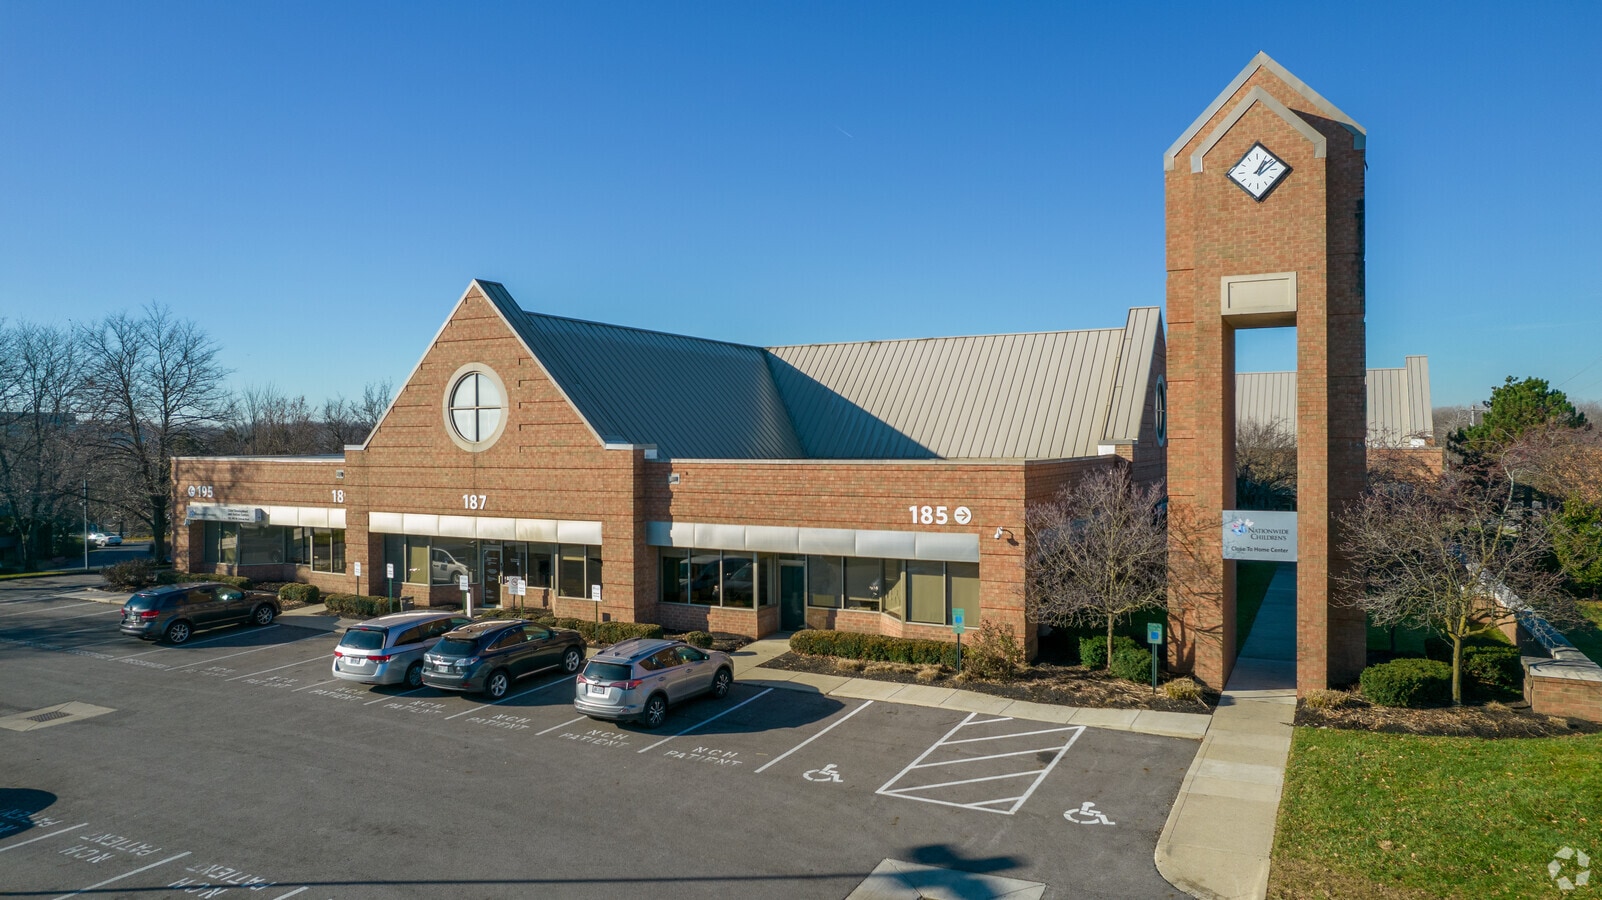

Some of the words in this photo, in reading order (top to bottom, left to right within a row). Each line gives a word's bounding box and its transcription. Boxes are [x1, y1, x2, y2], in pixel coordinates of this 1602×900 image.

[197, 485, 213, 498] 195
[331, 489, 346, 503] 18
[462, 494, 487, 510] 187
[908, 505, 948, 525] 185
[465, 717, 530, 729] PATIENT
[492, 713, 531, 724] NCH
[559, 732, 630, 748] PATIENT
[587, 729, 629, 740] NCH
[664, 750, 743, 766] PATIENT
[692, 746, 738, 759] NCH
[80, 832, 162, 856] PATIENT
[59, 844, 115, 864] NCH
[168, 877, 228, 899] NCH
